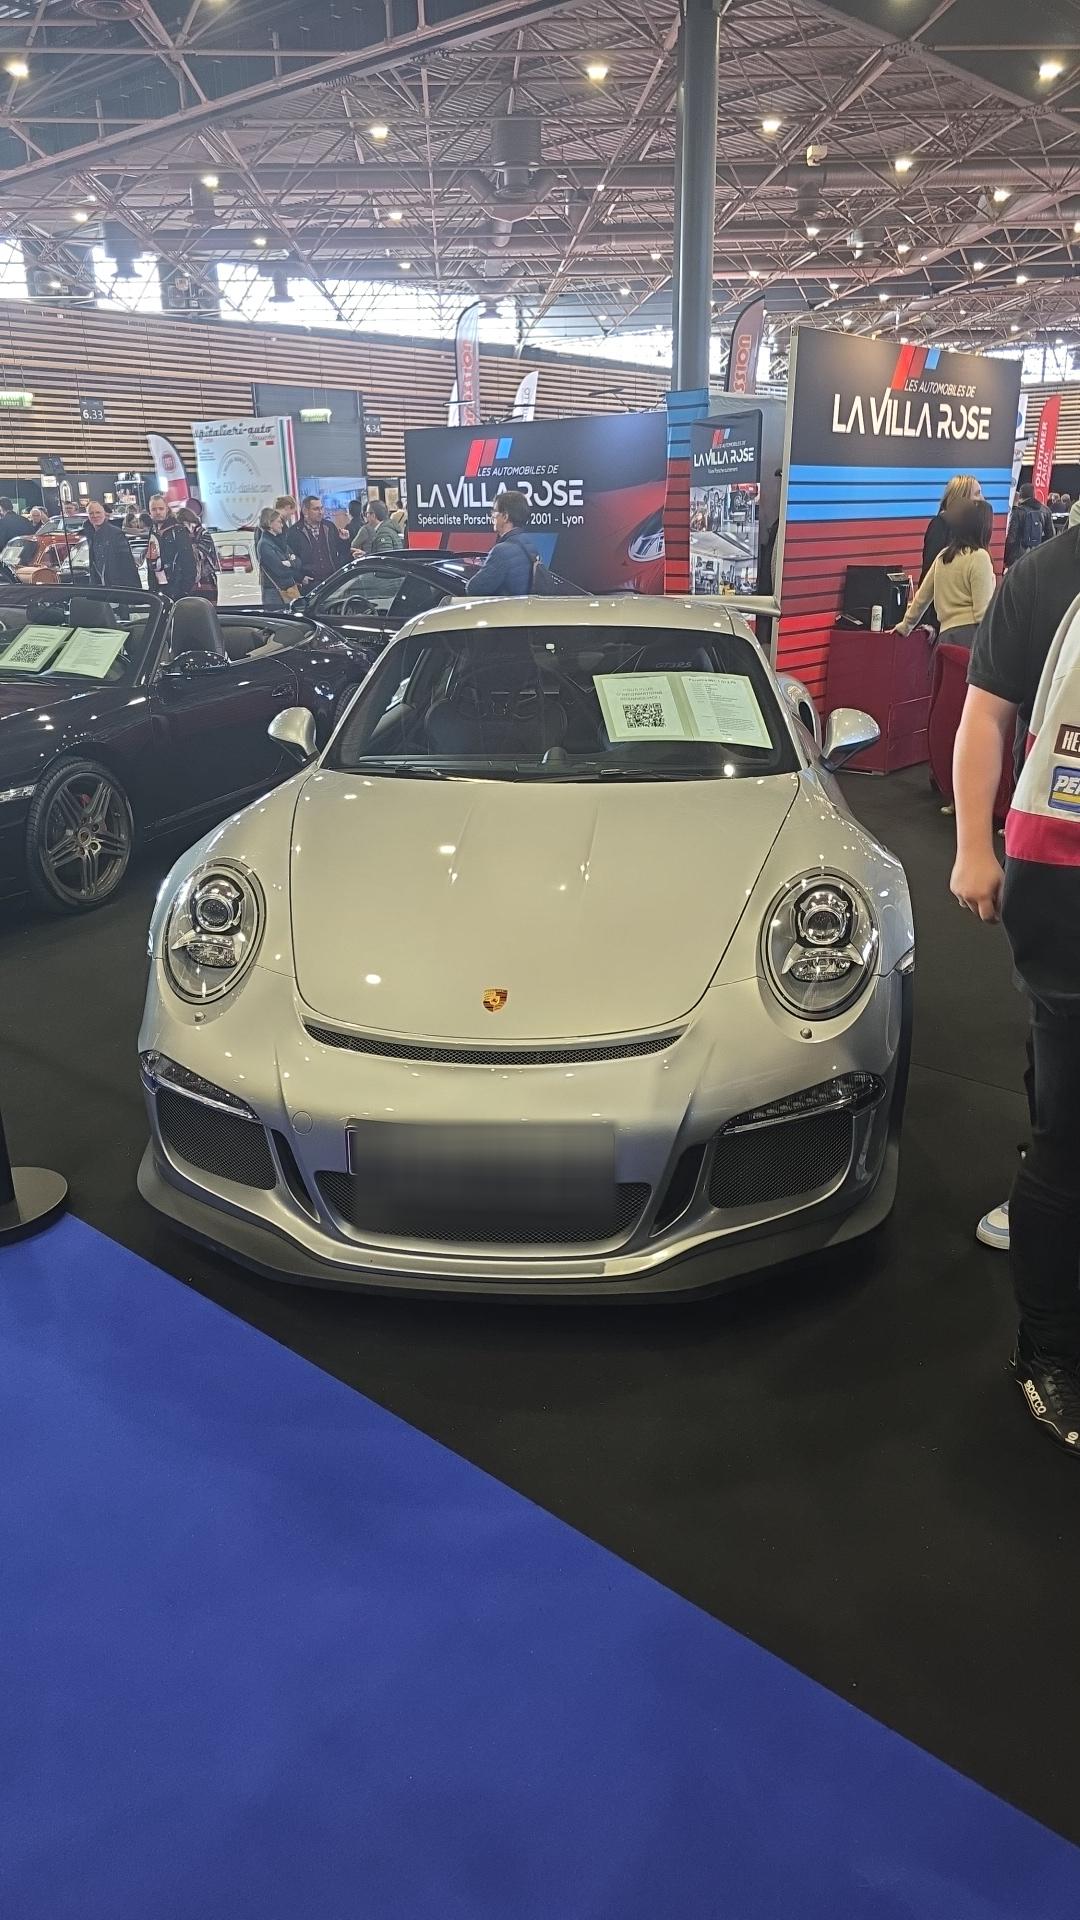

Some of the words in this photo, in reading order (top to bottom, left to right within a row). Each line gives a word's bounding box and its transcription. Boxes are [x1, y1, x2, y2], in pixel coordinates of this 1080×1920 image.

[904, 379, 918, 392] LES
[919, 382, 966, 397] AUTOMOBILES
[966, 385, 976, 398] DE
[83, 409, 103, 420] 6.33
[832, 393, 865, 435] LA
[870, 387, 933, 438] VILLA
[937, 403, 992, 440] ROSE
[366, 424, 381, 433] 6.34
[694, 453, 704, 467] LA
[705, 448, 729, 466] VILLA
[730, 447, 755, 464] ROSE
[1035, 421, 1049, 488] OLDTIMER
[478, 467, 491, 477] LES
[492, 466, 546, 477] AUTOMOBILES
[547, 464, 559, 475] DE
[416, 484, 445, 508] LA
[517, 479, 584, 508] ROSE
[417, 513, 461, 527] Spécialiste
[530, 513, 551, 526] 2001
[561, 513, 584, 528] Lyon
[1061, 730, 1080, 753] HE
